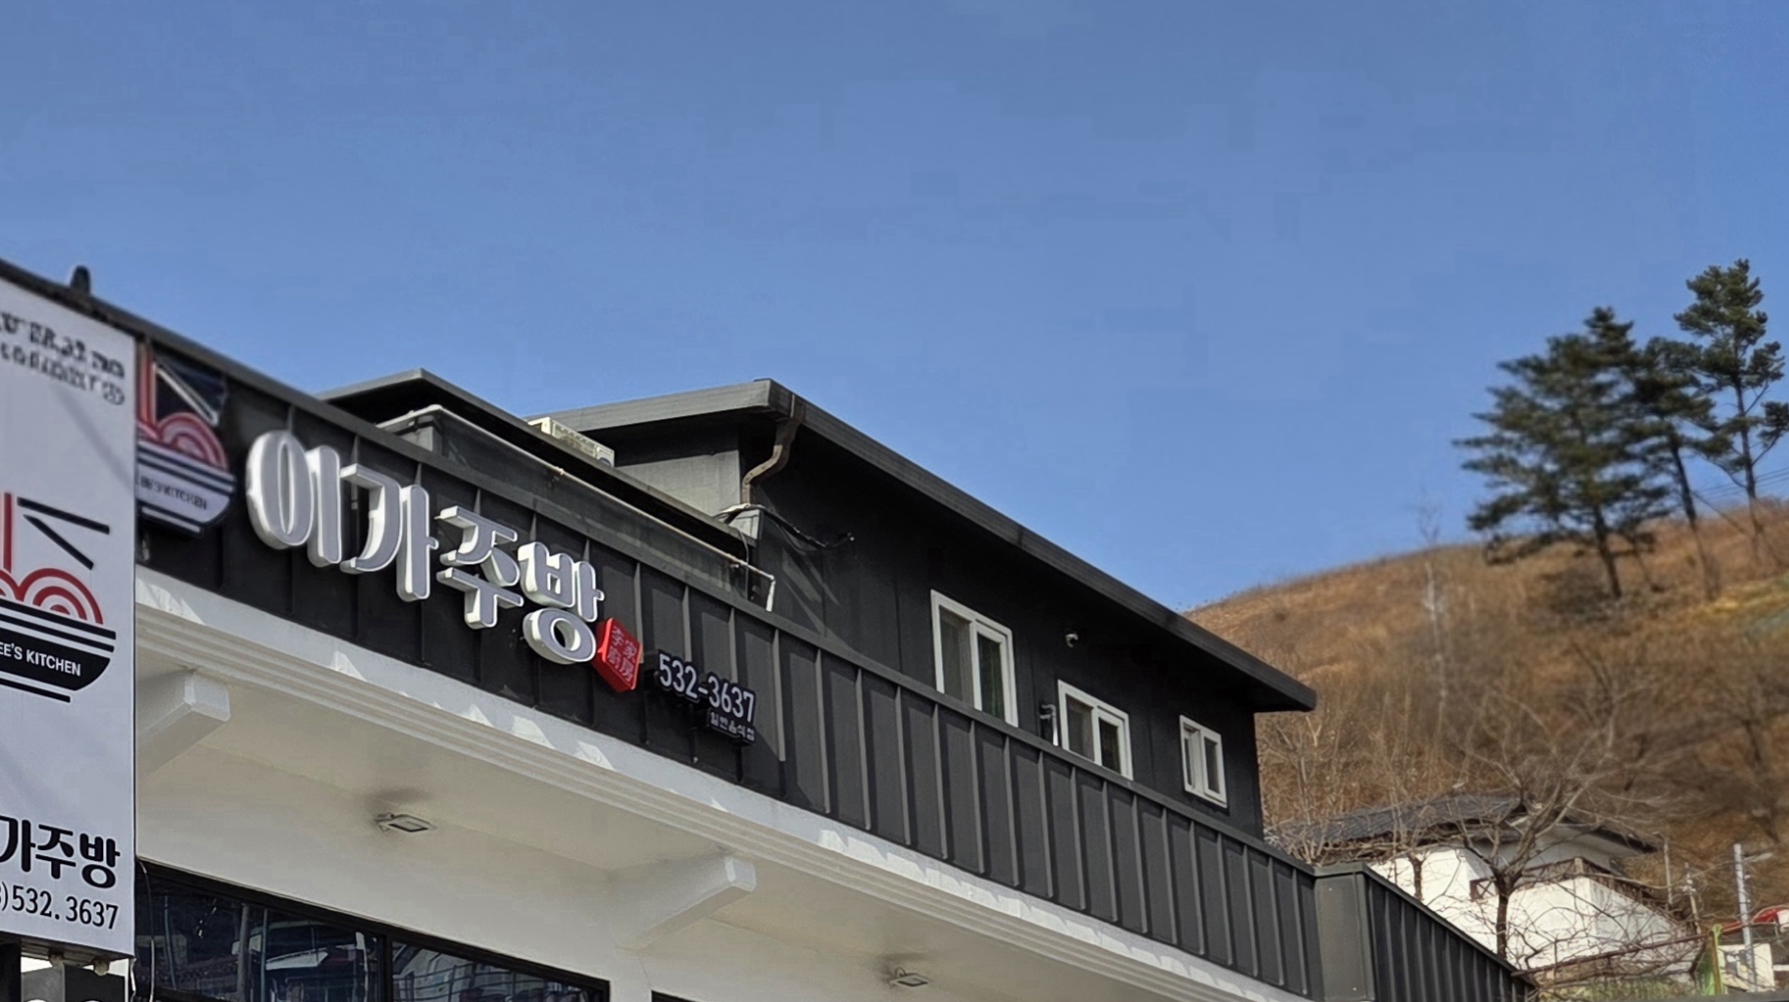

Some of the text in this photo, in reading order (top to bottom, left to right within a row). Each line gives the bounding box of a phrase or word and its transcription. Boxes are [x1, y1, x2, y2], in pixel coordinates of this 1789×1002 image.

[246, 430, 605, 664] 이가주방
[26, 659, 81, 687] KITCHEN
[659, 653, 754, 722] 532-3637
